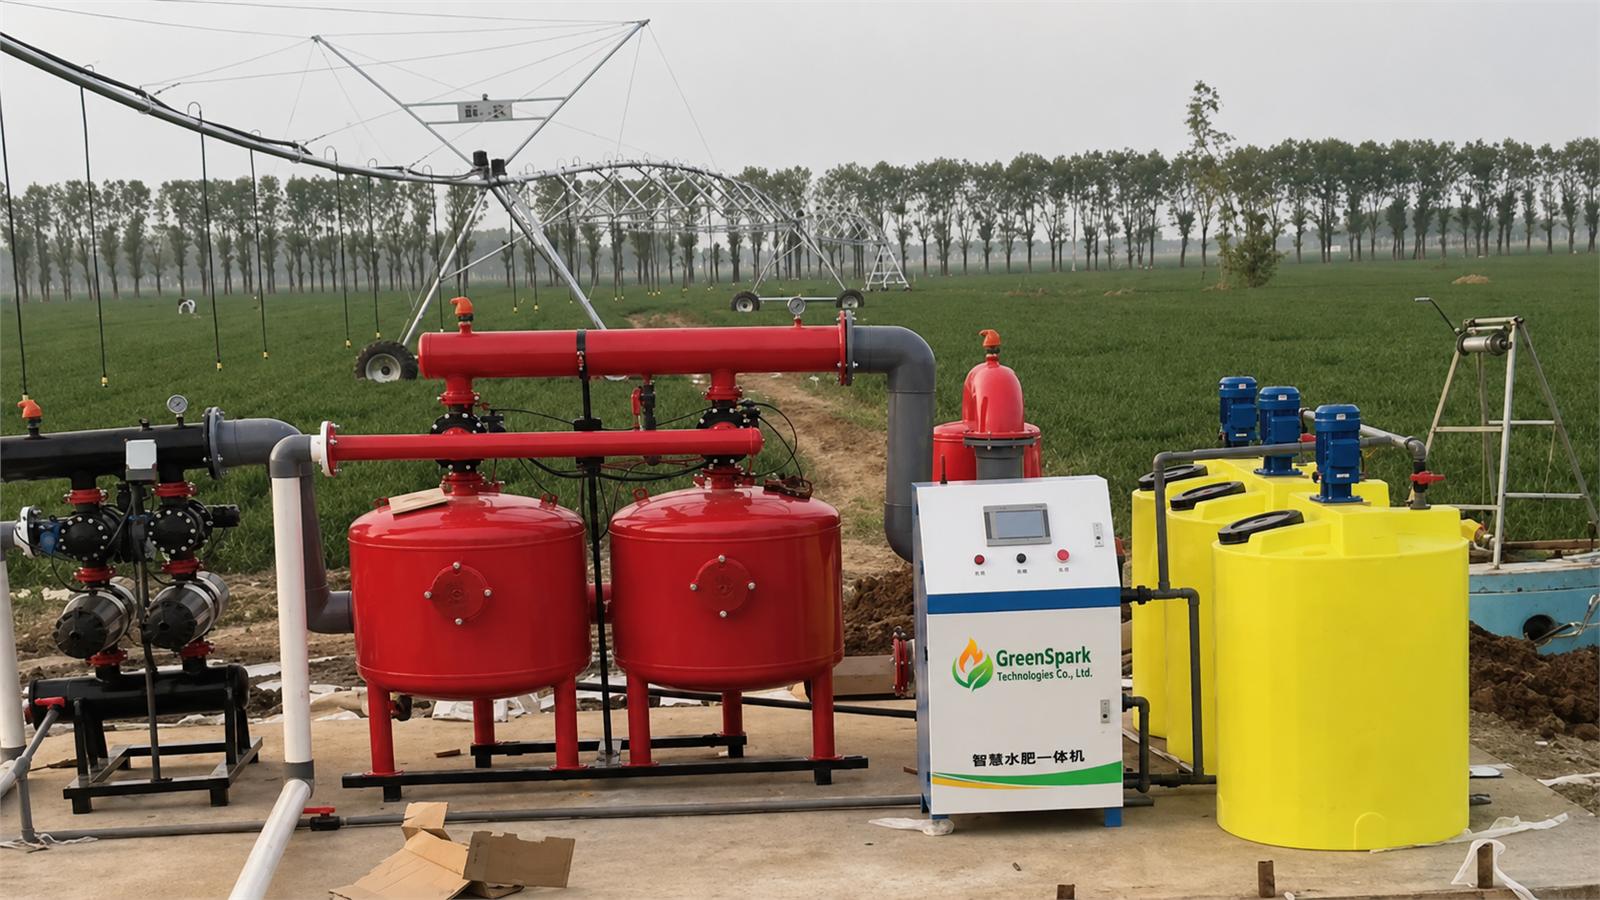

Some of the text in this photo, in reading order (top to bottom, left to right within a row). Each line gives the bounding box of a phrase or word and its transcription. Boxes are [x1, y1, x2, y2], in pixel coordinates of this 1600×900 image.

[996, 645, 1091, 669] GreenSpark
[997, 667, 1093, 682] Technologies Co., Ltd.
[972, 749, 1085, 767] 智慧水肥一体机
